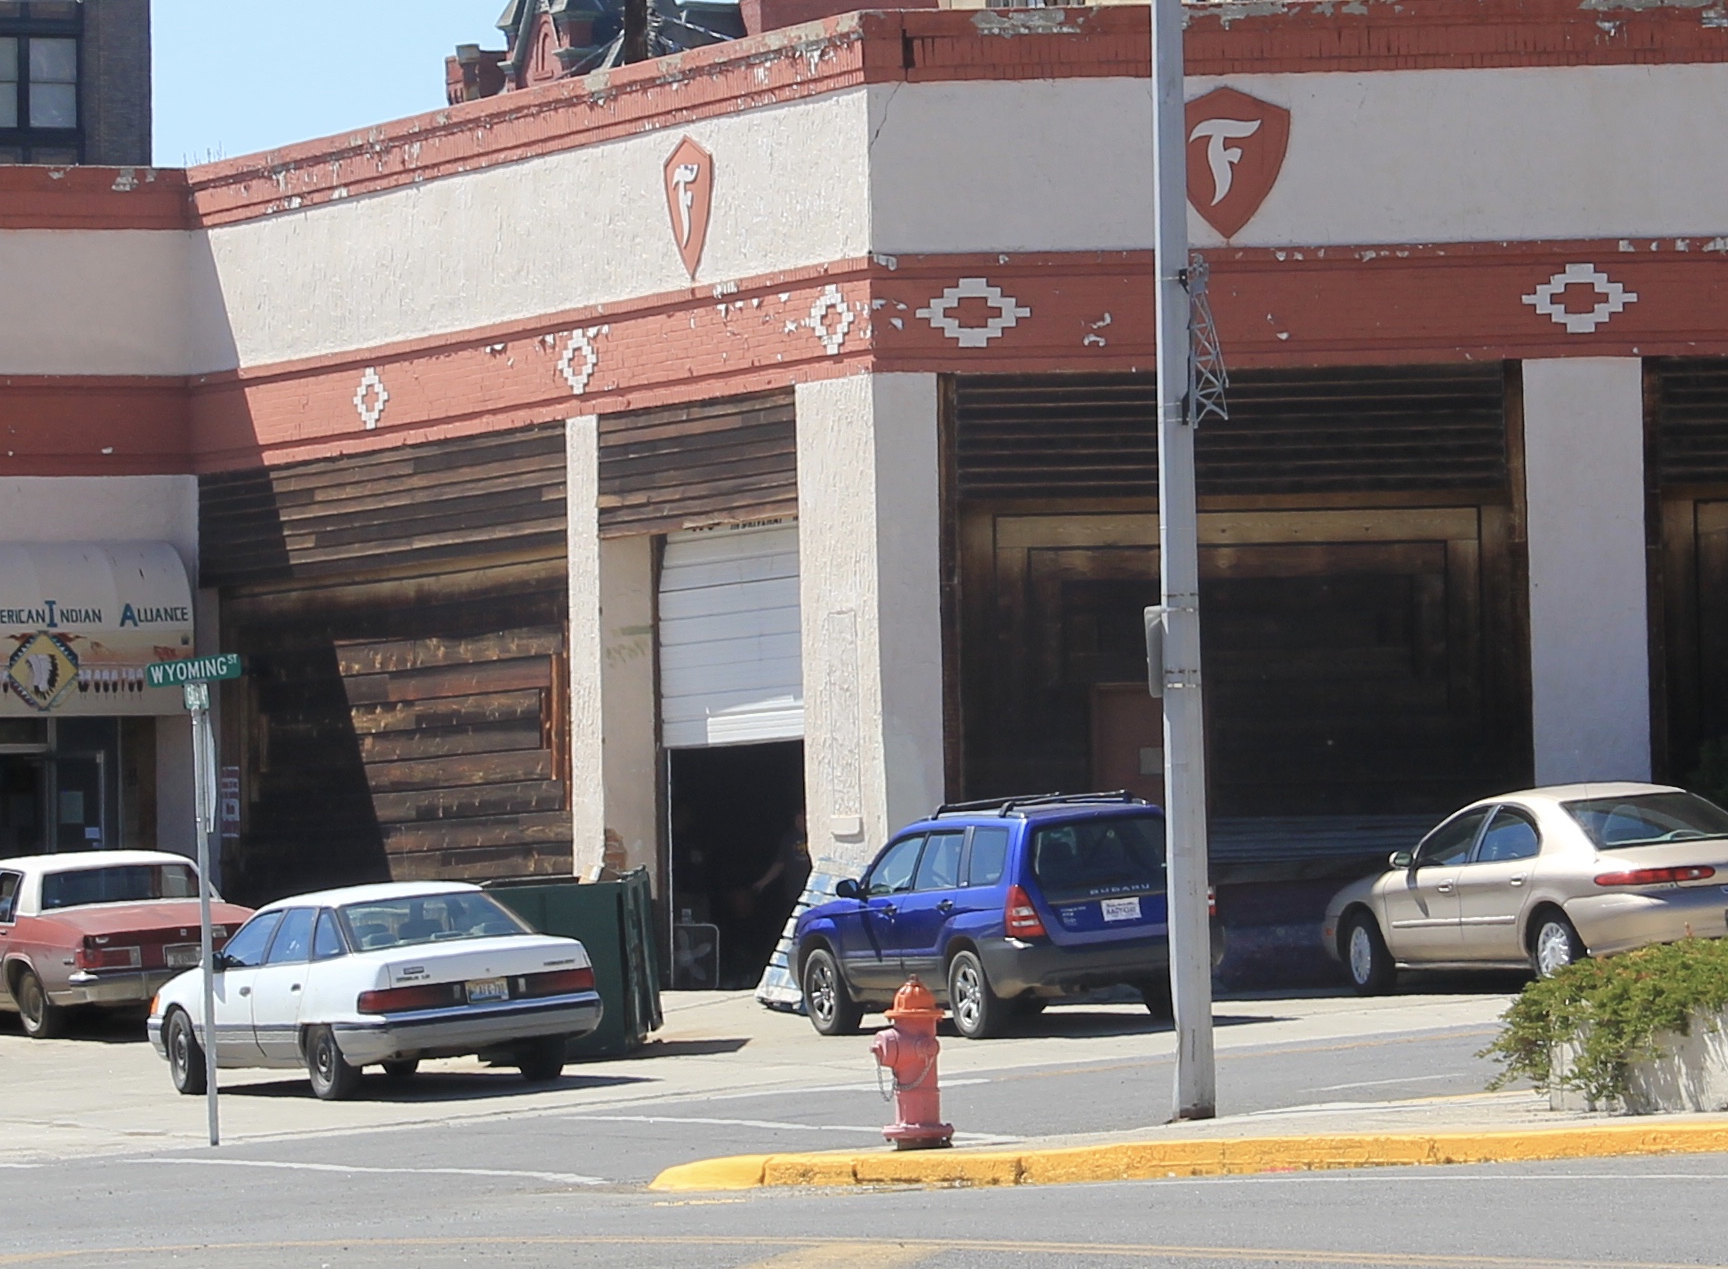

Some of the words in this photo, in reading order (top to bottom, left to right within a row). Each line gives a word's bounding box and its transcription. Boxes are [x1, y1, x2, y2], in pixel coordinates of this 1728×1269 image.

[119, 603, 189, 627] ALLIANCE
[150, 656, 227, 684] WYOMING
[227, 654, 238, 664] ST
